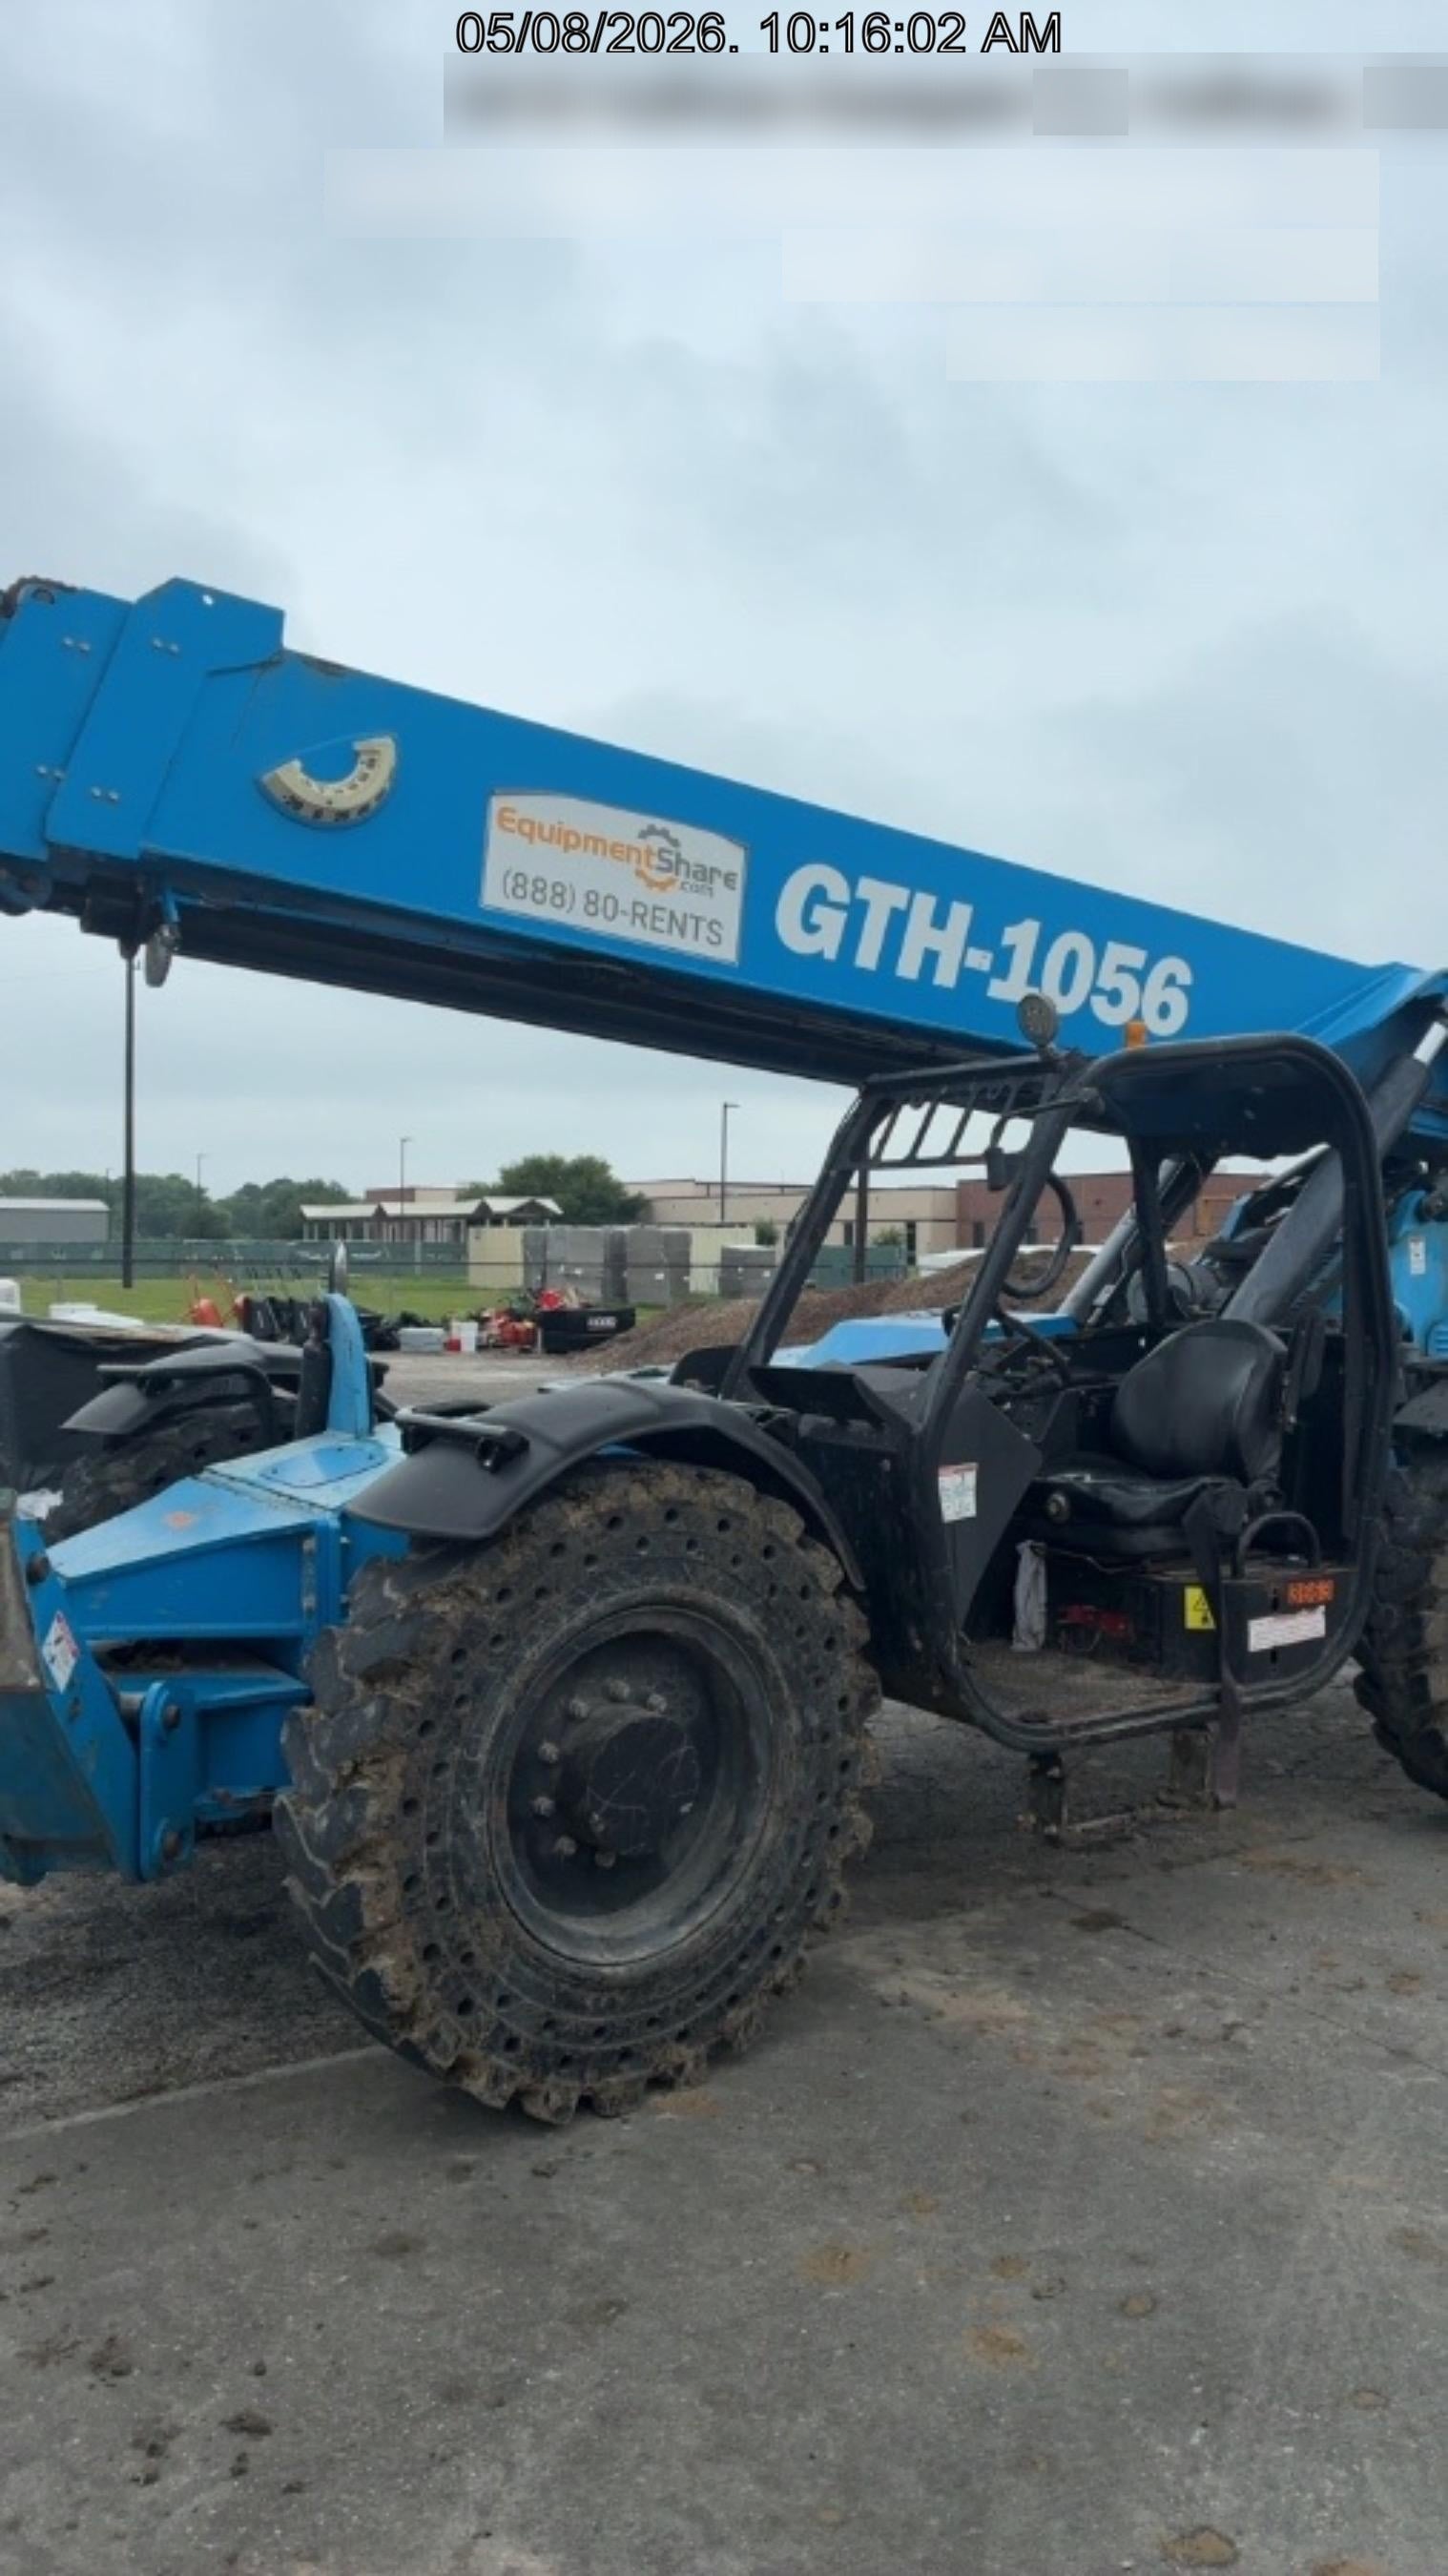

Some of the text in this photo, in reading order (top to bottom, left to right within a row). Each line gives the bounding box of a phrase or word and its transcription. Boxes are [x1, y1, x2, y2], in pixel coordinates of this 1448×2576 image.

[502, 867, 724, 946] (888) 80-RENTS
[775, 862, 1192, 1037] GTH-1056
